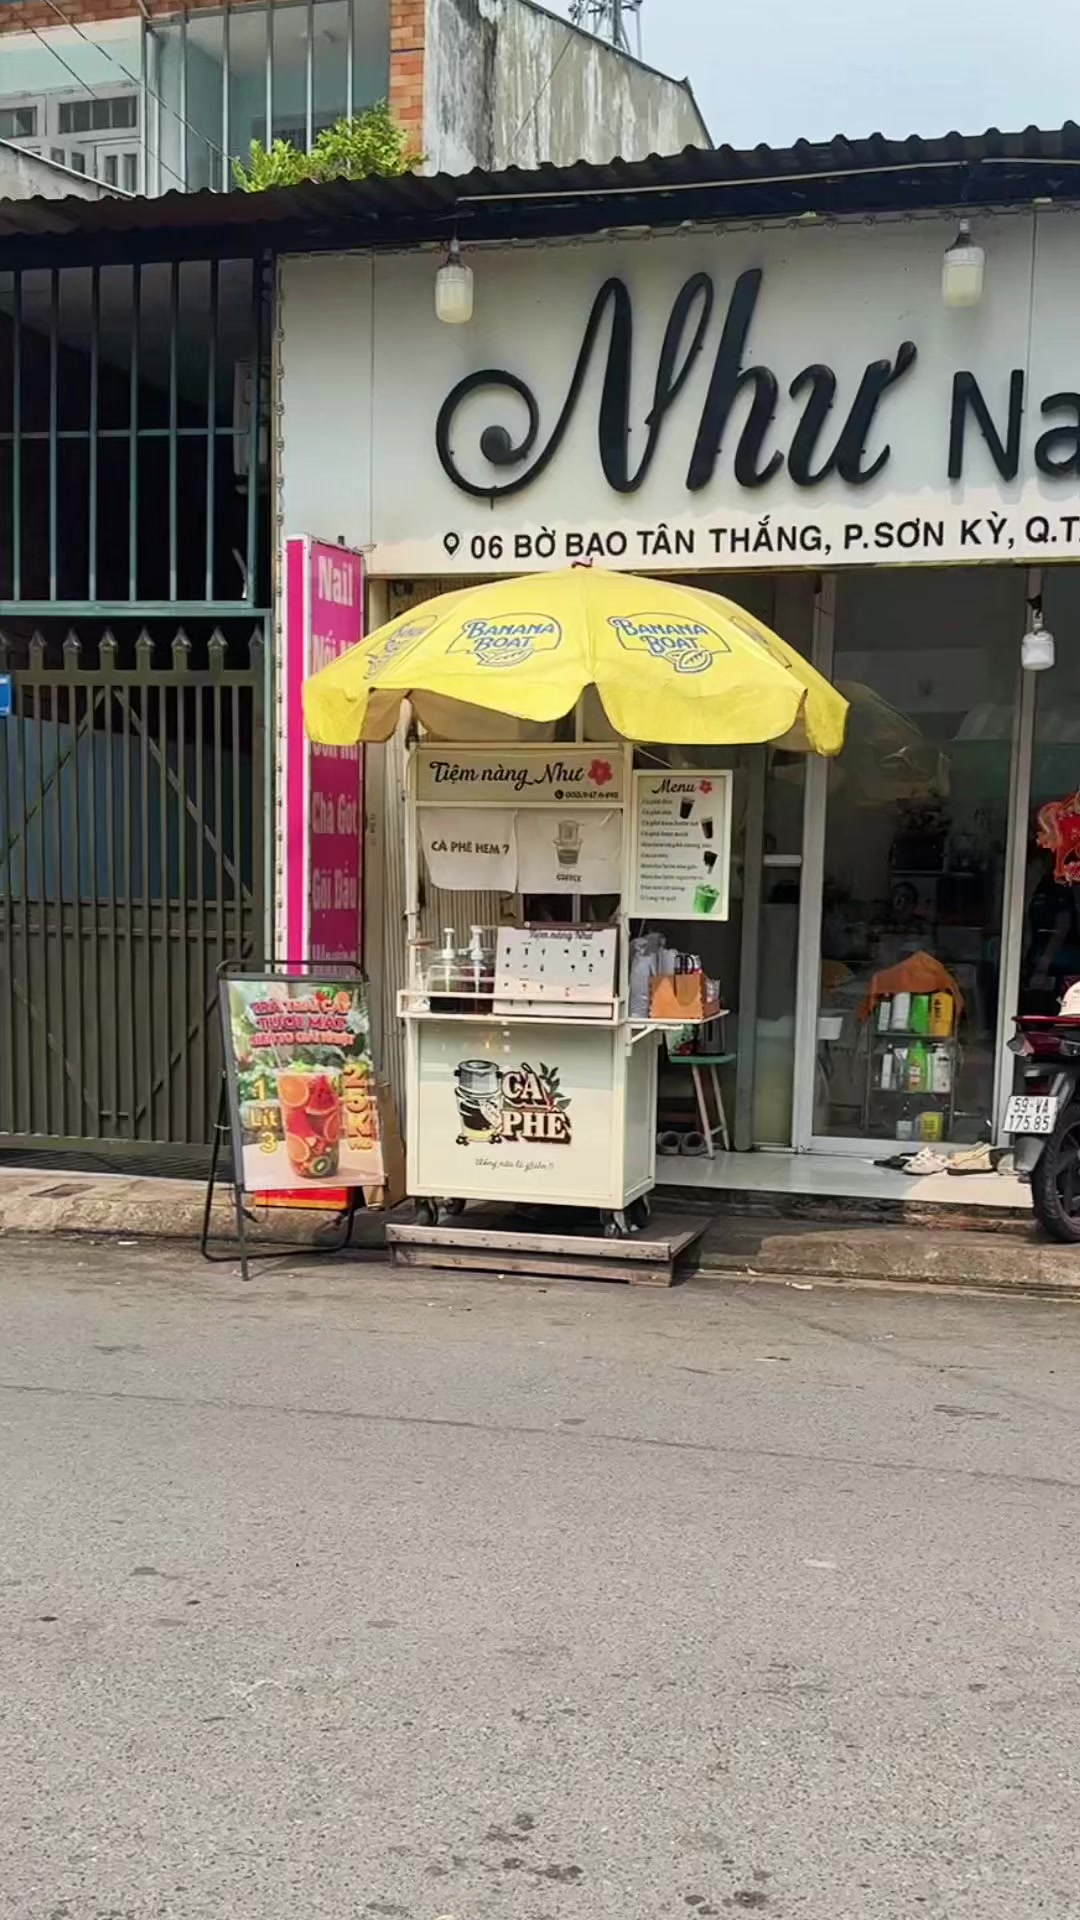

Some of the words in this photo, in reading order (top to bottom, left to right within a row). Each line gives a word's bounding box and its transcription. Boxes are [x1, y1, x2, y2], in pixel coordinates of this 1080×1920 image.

[436, 268, 917, 494] Như
[470, 534, 503, 559] 06
[514, 526, 556, 558] BỜ
[566, 530, 627, 557] BAO
[637, 523, 694, 555] TÂN
[709, 513, 831, 555] THẮNG,
[844, 518, 944, 550] P.SƠN
[960, 510, 1014, 549] KỲ,
[1025, 515, 1080, 543] Q.T
[317, 554, 354, 607] Nail
[466, 621, 554, 639] BANANA
[613, 619, 708, 636] BANANA
[474, 636, 535, 652] BOAT
[640, 635, 698, 654] BOAT
[430, 760, 478, 784] Tiệm
[481, 764, 534, 791] nàng
[533, 762, 584, 784] Như
[651, 778, 696, 794] Menu
[431, 839, 447, 852] CÀ
[475, 843, 501, 855] HEM
[501, 1062, 552, 1107] CÀ
[500, 1106, 571, 1145] PHÊ
[260, 1131, 275, 1153] 3
